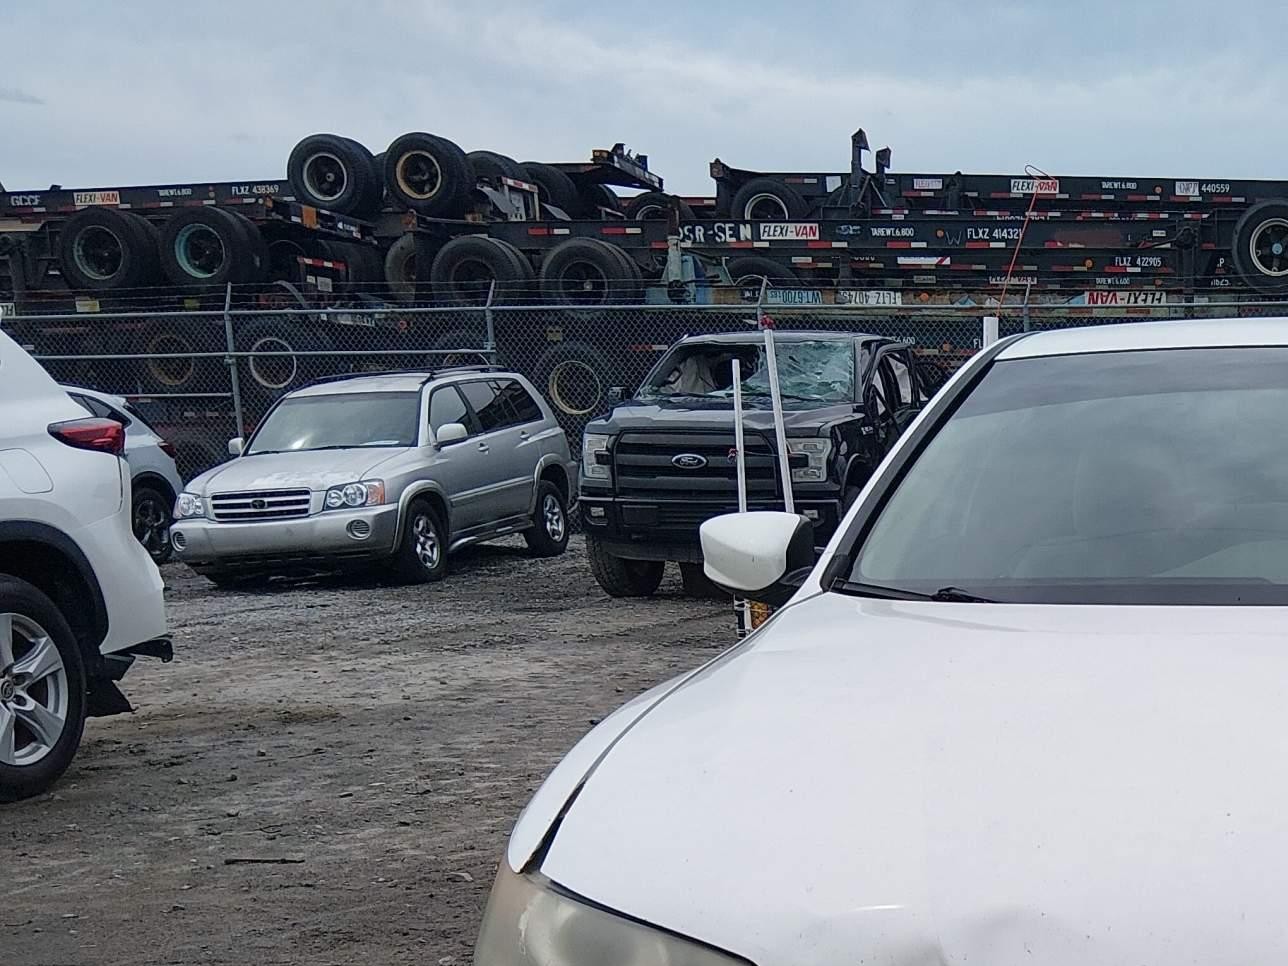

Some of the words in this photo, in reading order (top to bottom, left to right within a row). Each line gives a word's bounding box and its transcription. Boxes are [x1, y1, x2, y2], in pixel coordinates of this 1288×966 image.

[231, 186, 250, 196] FLXZ
[1012, 180, 1057, 192] FLEXI-VAN
[1201, 183, 1230, 193] 440559
[75, 193, 118, 204] FLEXI-VAN
[762, 225, 817, 237] FLEXI-VAN
[967, 228, 990, 239] FLXZ
[992, 228, 1022, 239] 414321
[1115, 256, 1132, 267] FLXZ
[1136, 256, 1162, 267] 422905
[1088, 291, 1164, 305] FLEXI-VAN
